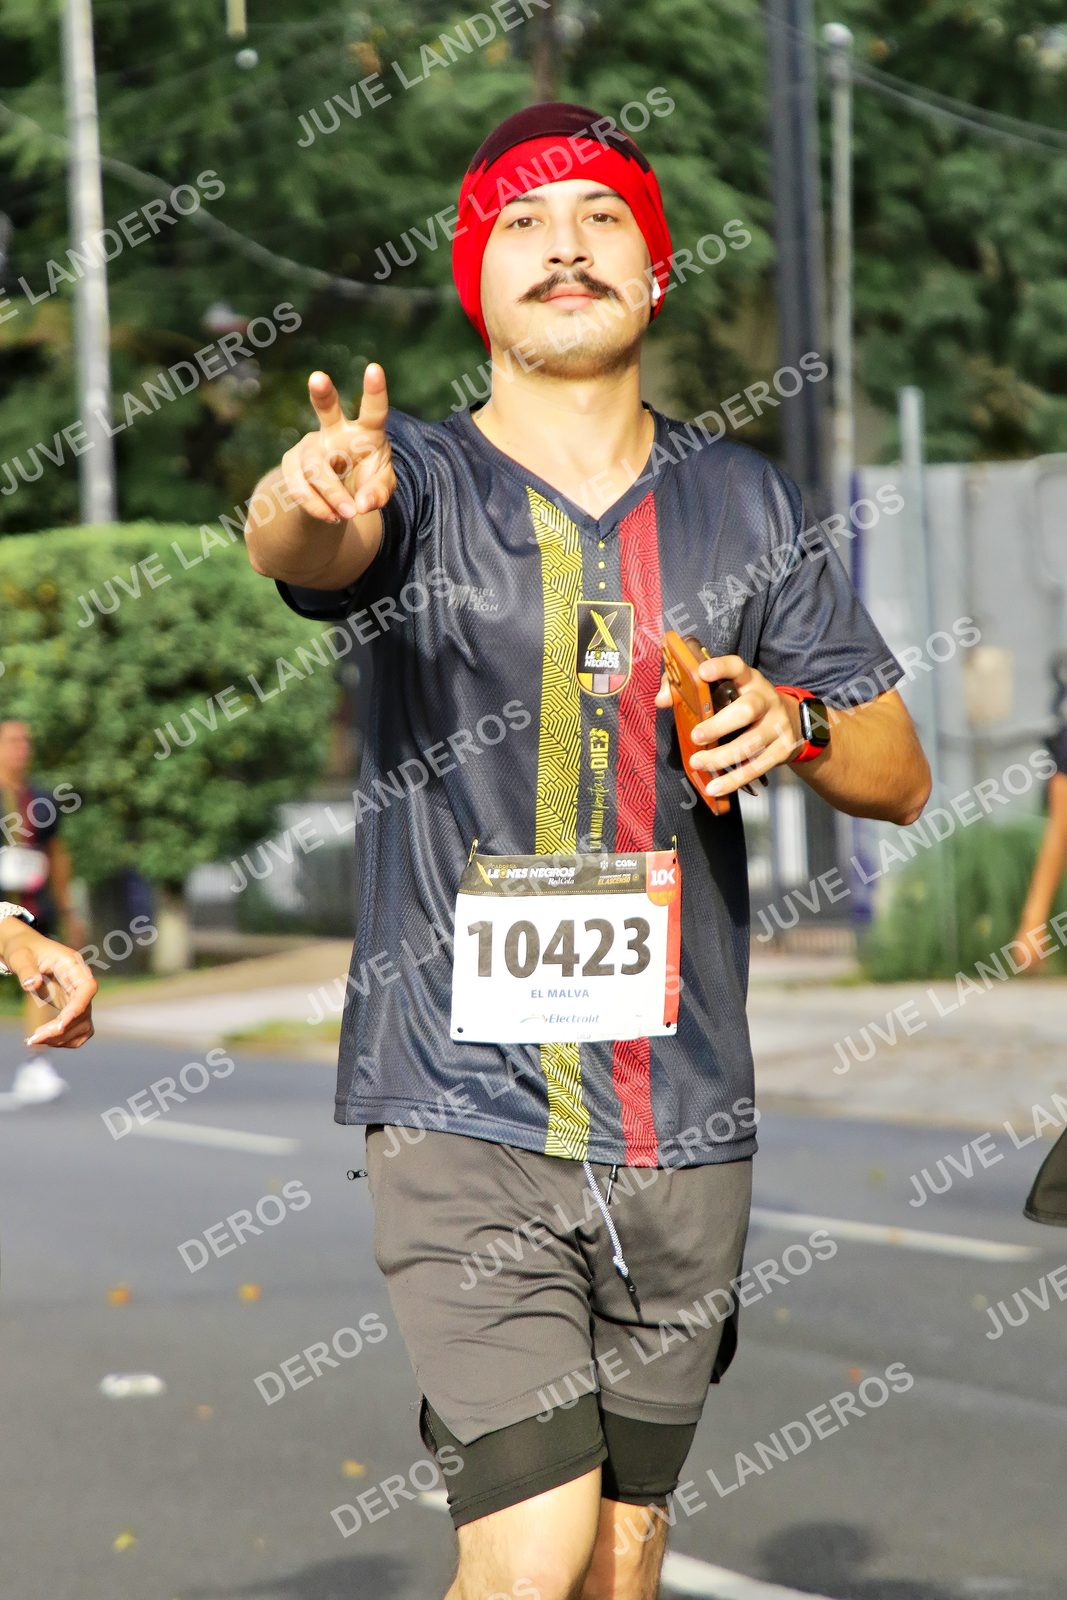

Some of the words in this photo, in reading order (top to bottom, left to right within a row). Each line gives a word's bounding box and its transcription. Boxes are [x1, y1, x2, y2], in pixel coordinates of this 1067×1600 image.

[584, 660, 620, 668] NEGROS
[529, 867, 575, 878] NEGROS
[467, 917, 651, 978] 10423
[531, 989, 544, 998] EL
[547, 989, 590, 998] MALVA
